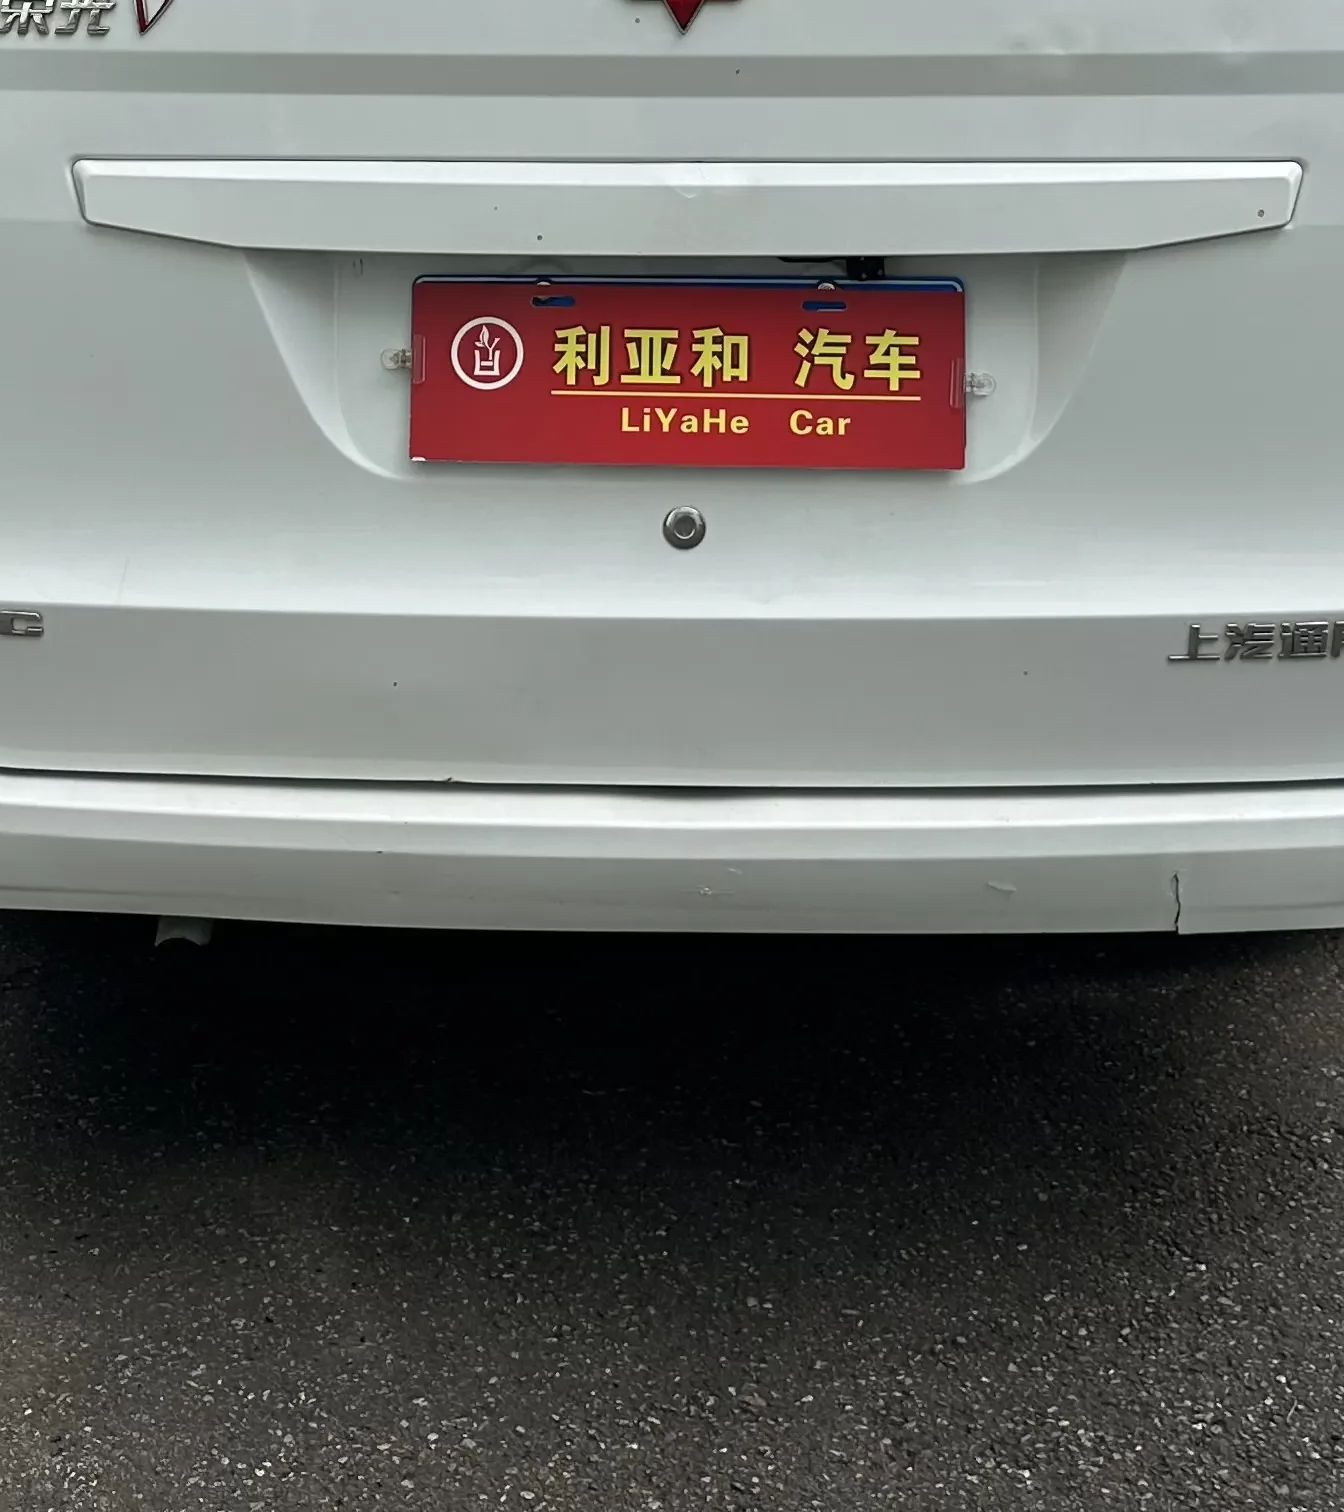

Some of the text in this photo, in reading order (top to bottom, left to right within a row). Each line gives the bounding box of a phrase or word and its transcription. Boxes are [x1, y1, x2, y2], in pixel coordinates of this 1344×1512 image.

[553, 325, 921, 391] 利亚和 汽车
[621, 407, 851, 436] LiYaHe Car
